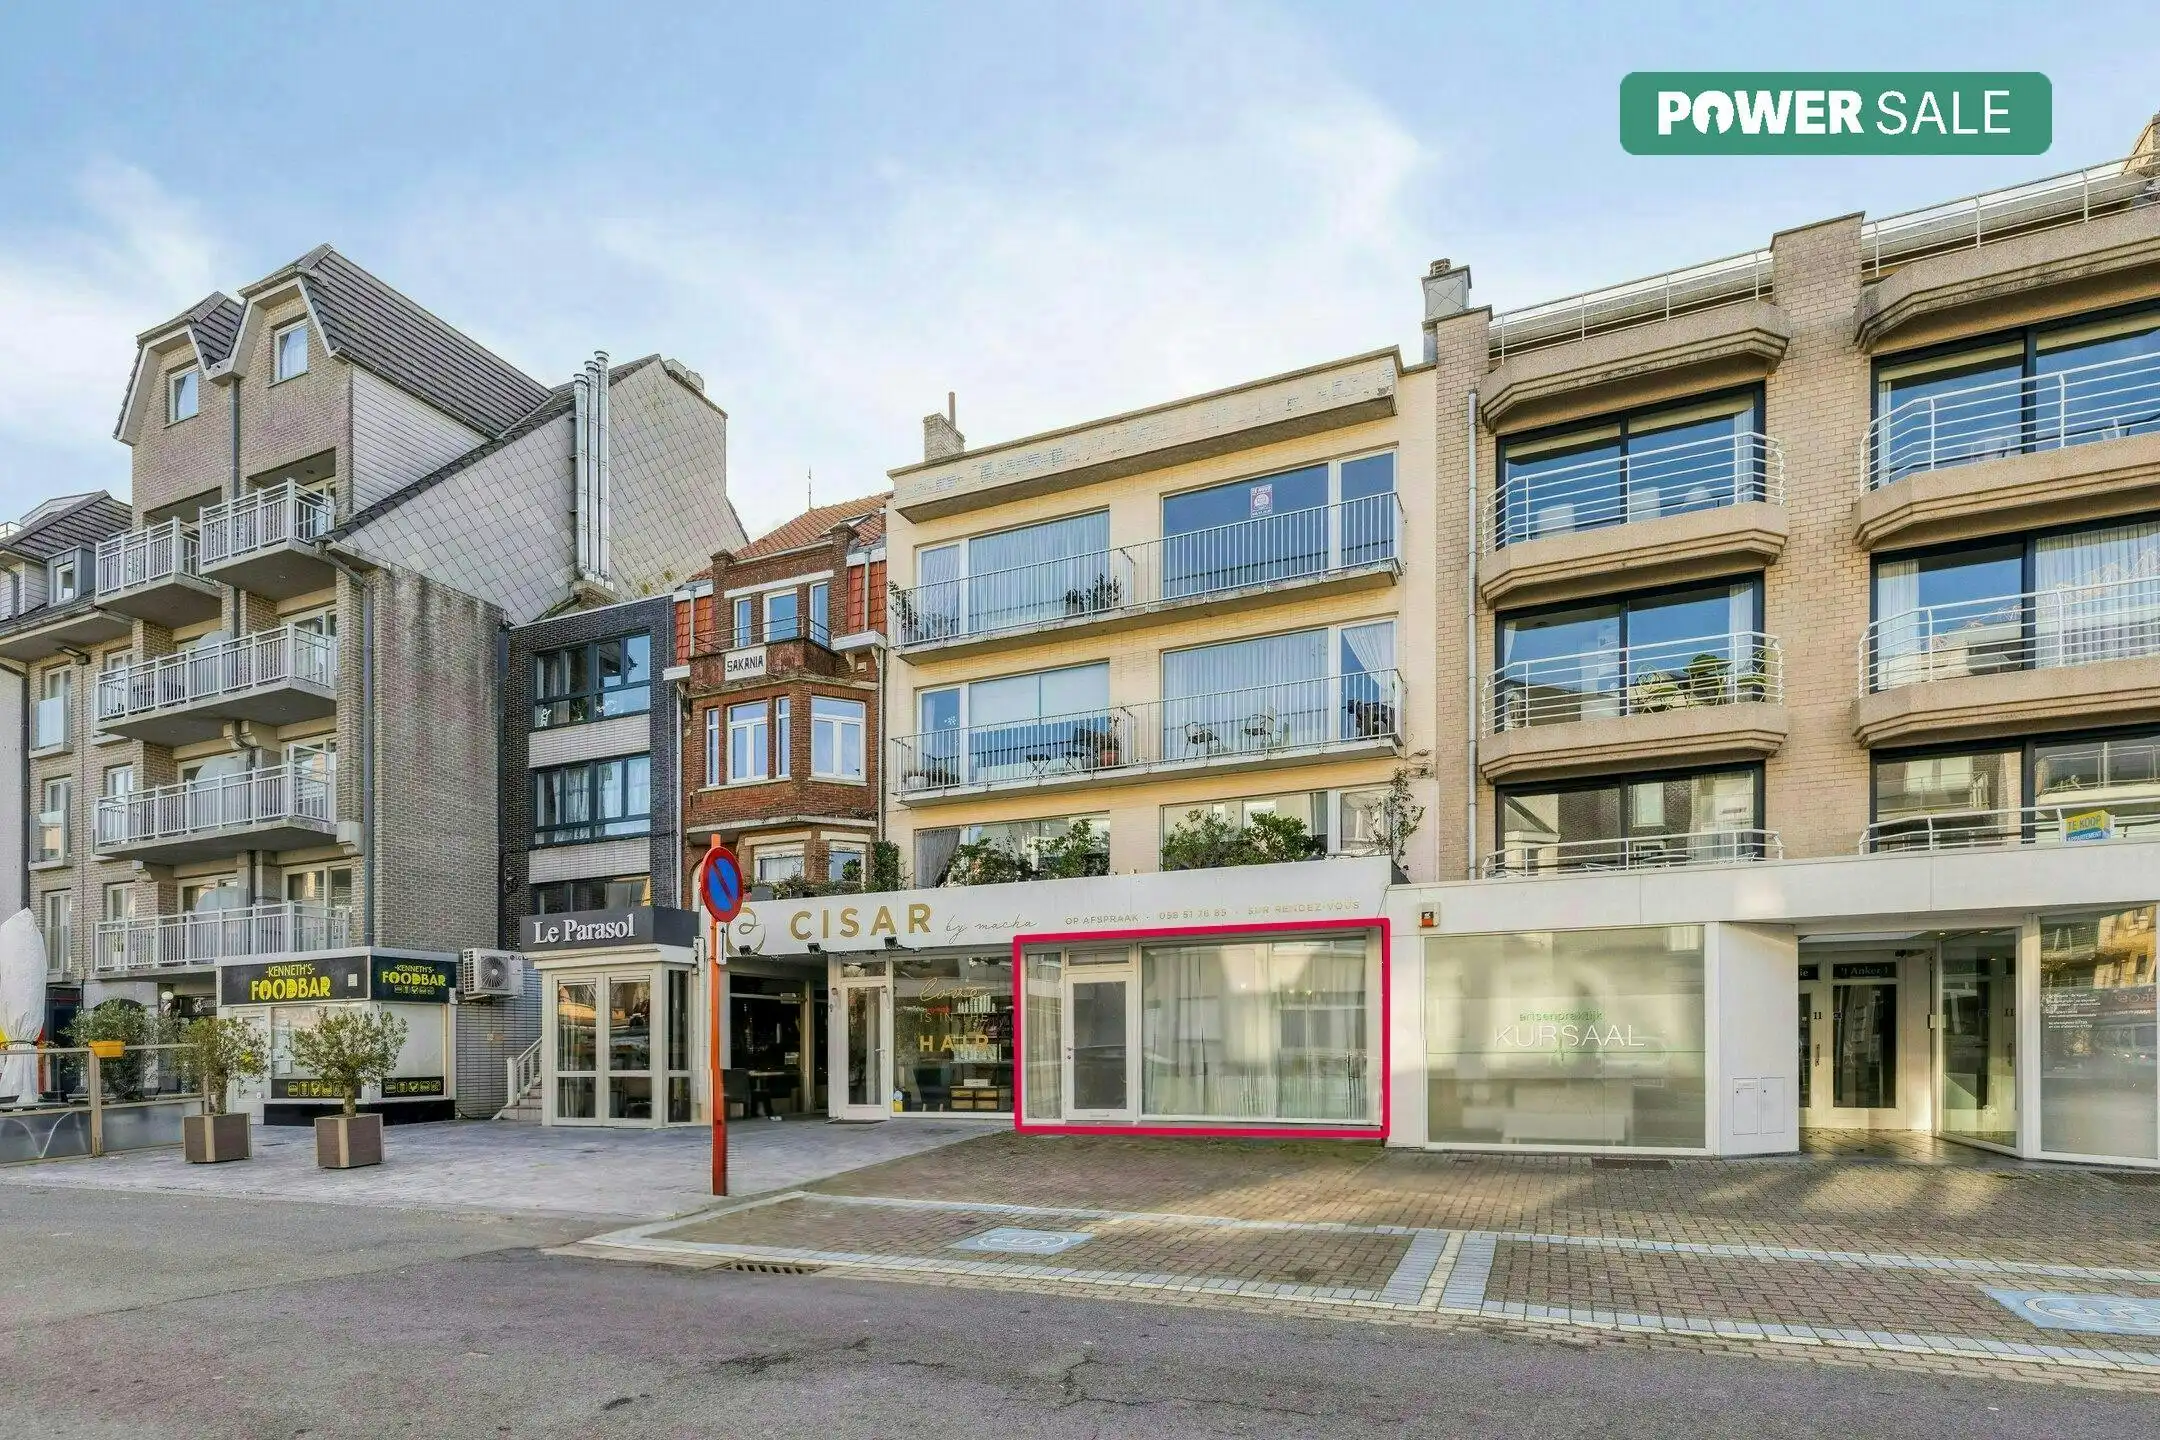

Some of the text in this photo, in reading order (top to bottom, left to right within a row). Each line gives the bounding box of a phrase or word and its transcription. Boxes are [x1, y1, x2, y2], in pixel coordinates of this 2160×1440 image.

[727, 655, 764, 672] SAKANIA
[2068, 821, 2076, 831] TE
[789, 902, 932, 941] CISAR
[945, 913, 967, 944] by
[1065, 916, 1079, 925] OP
[1082, 914, 1140, 925] AFSPRAAK
[1247, 906, 1270, 915] SUR
[533, 913, 636, 944] Le Parasol
[381, 970, 446, 987] FOODBAR
[1850, 965, 1882, 976] Anker
[251, 976, 331, 1001] FOODBAR
[920, 977, 990, 1002] love
[920, 1011, 989, 1023] IS IN THE
[1812, 1011, 1823, 1021] 11
[919, 1033, 989, 1053] HAIR
[1494, 1024, 1645, 1047] KURSAAL
